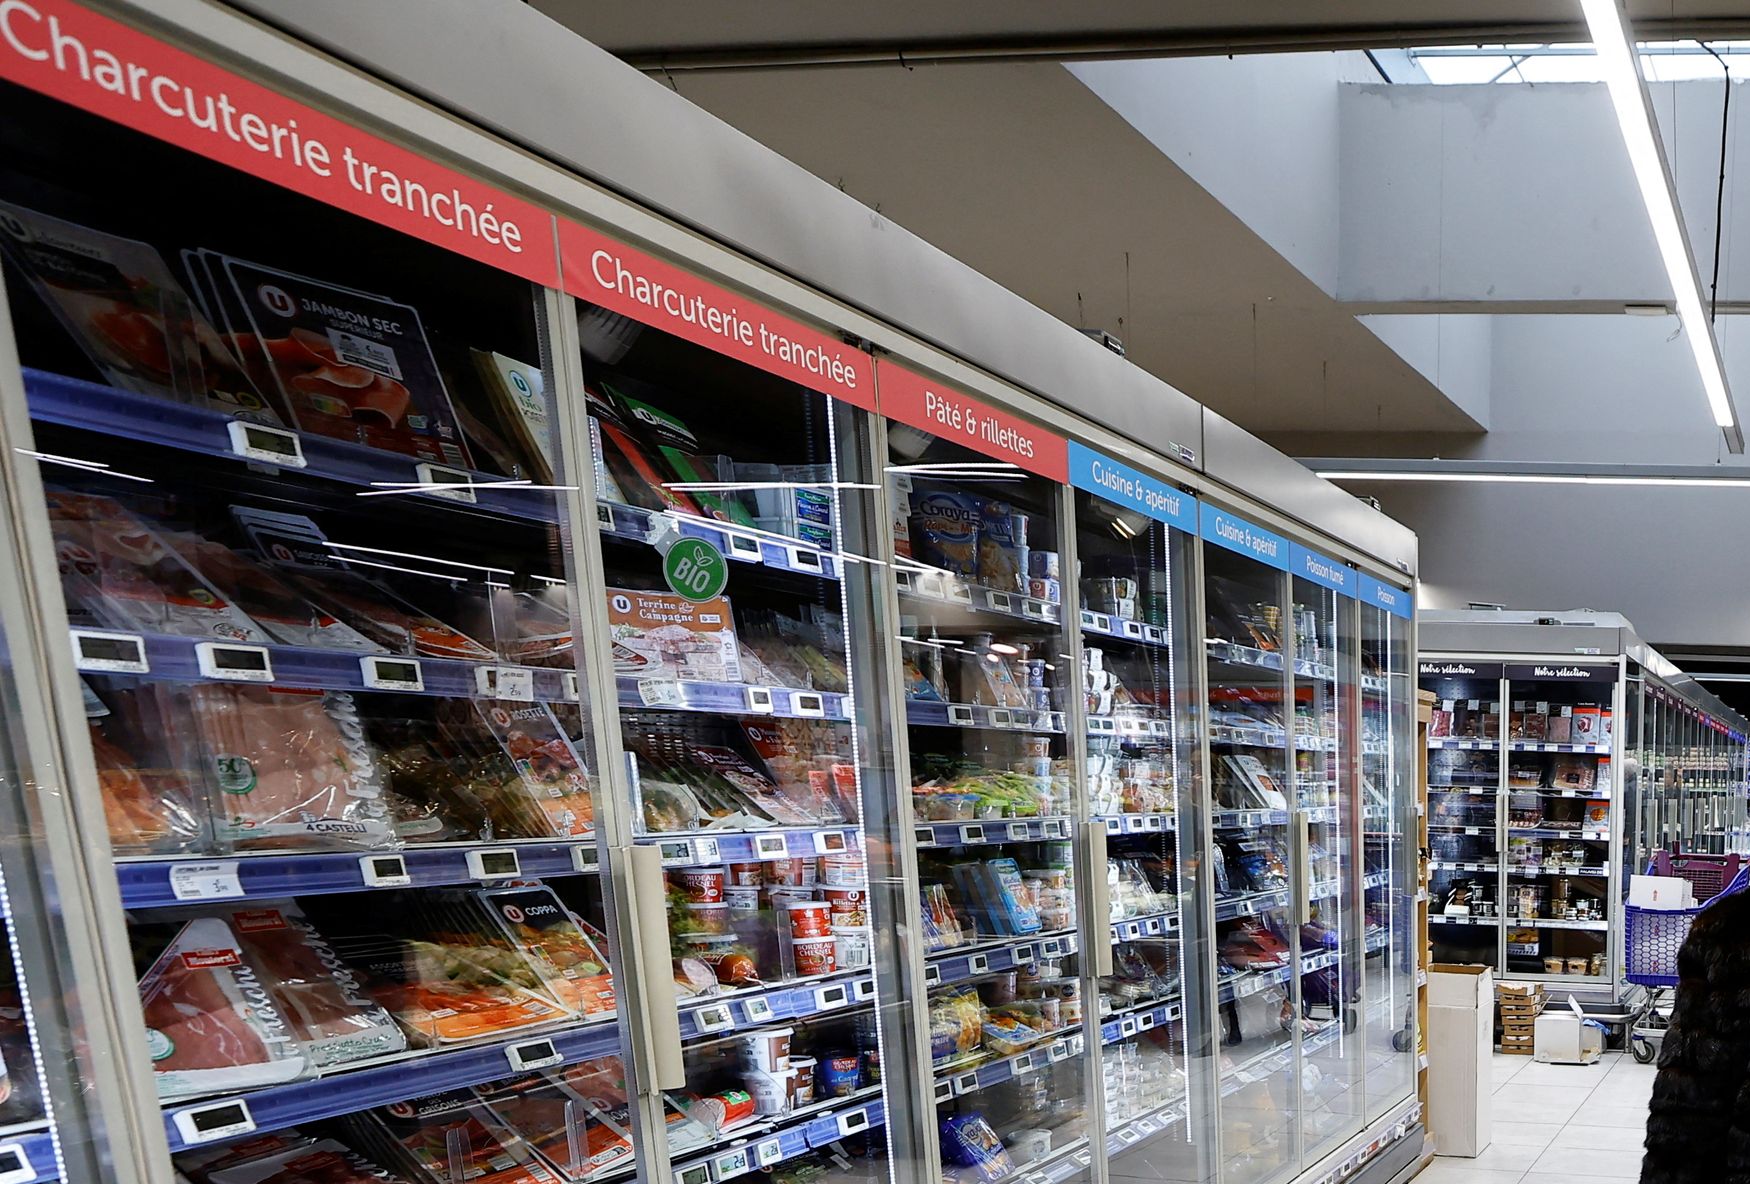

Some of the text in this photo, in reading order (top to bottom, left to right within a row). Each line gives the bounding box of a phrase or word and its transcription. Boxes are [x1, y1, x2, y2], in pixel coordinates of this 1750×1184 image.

[1, 0, 523, 254] Charcuterie tranchée
[301, 298, 403, 336] JAMBON SEC
[591, 250, 857, 389] Charcuterie tranchée
[925, 391, 1034, 459] Pâté & rillettes
[1092, 460, 1181, 518] Cuisine & apéritif
[921, 501, 971, 521] Coraya
[1215, 516, 1278, 559] Cuisine & apéritif
[672, 558, 711, 593] BIO
[1306, 555, 1345, 587] Poisson fumé
[636, 597, 676, 611] Terrine
[1377, 587, 1395, 605] Poisson
[639, 607, 694, 624] Campagne
[1420, 663, 1476, 676] Notre sélection
[1534, 666, 1591, 678] Notre sélection
[511, 707, 546, 722] ROSETTE
[314, 823, 367, 834] CASTELLI
[525, 904, 558, 917] COPPA
[418, 1098, 463, 1116] GRISONS
